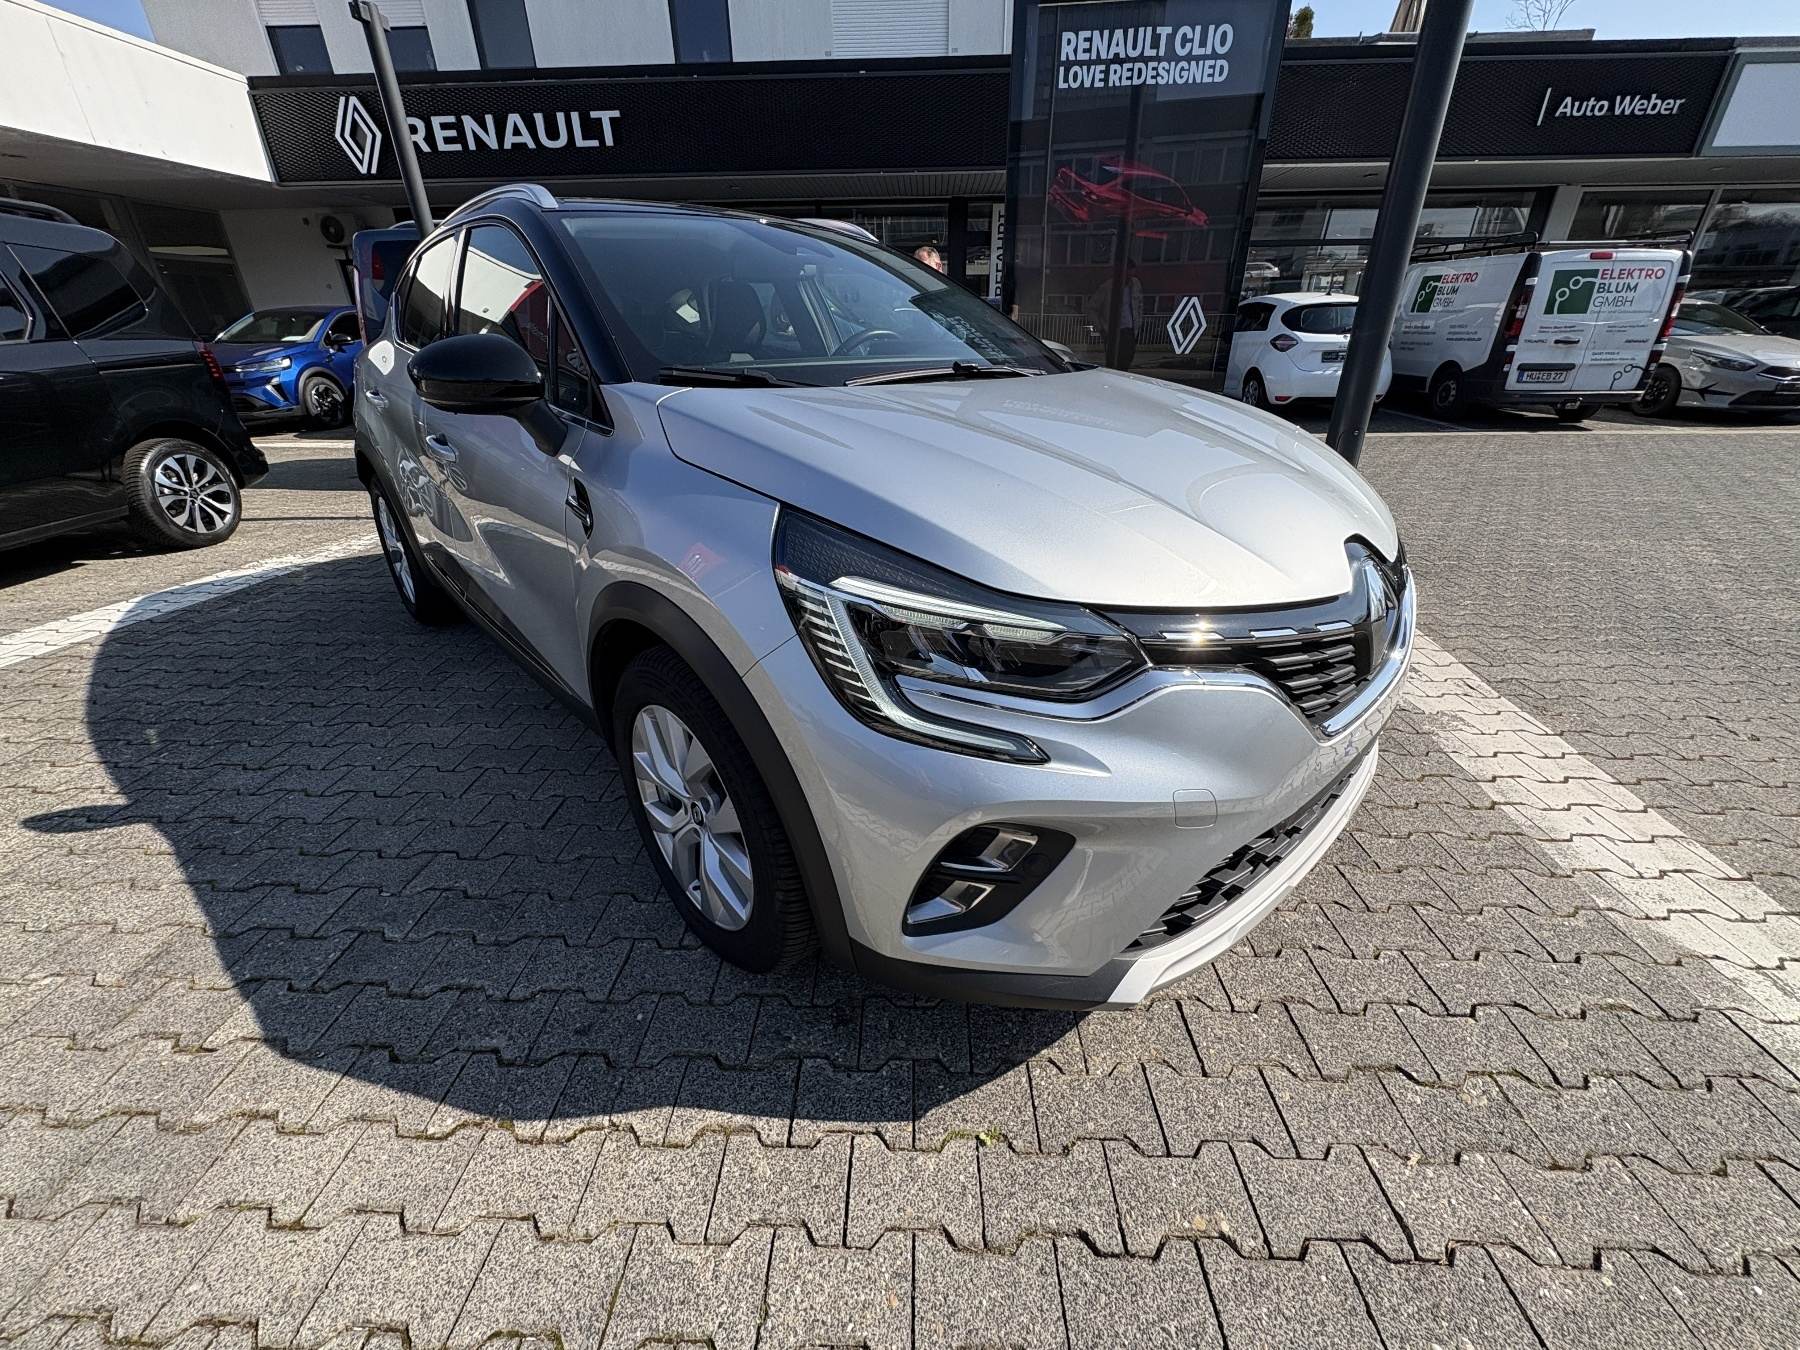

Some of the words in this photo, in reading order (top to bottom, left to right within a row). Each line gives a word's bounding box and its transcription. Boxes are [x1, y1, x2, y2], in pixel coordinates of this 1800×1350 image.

[1061, 26, 1172, 61] RENAULT
[1174, 23, 1234, 56] CLIO
[1058, 65, 1106, 89] LOVE
[1108, 59, 1229, 87] REDESIGNED
[1555, 96, 1609, 117] Auto
[1614, 93, 1686, 115] Weber
[406, 110, 621, 152] RENAULT
[1441, 271, 1479, 284] ELEKTRO
[1600, 268, 1666, 280] ELEKTRO
[1437, 285, 1460, 296] BLUM
[1596, 282, 1639, 294] BLUM
[1592, 296, 1635, 308] GMBH
[1526, 372, 1537, 381] HU
[1552, 372, 1564, 380] 27
